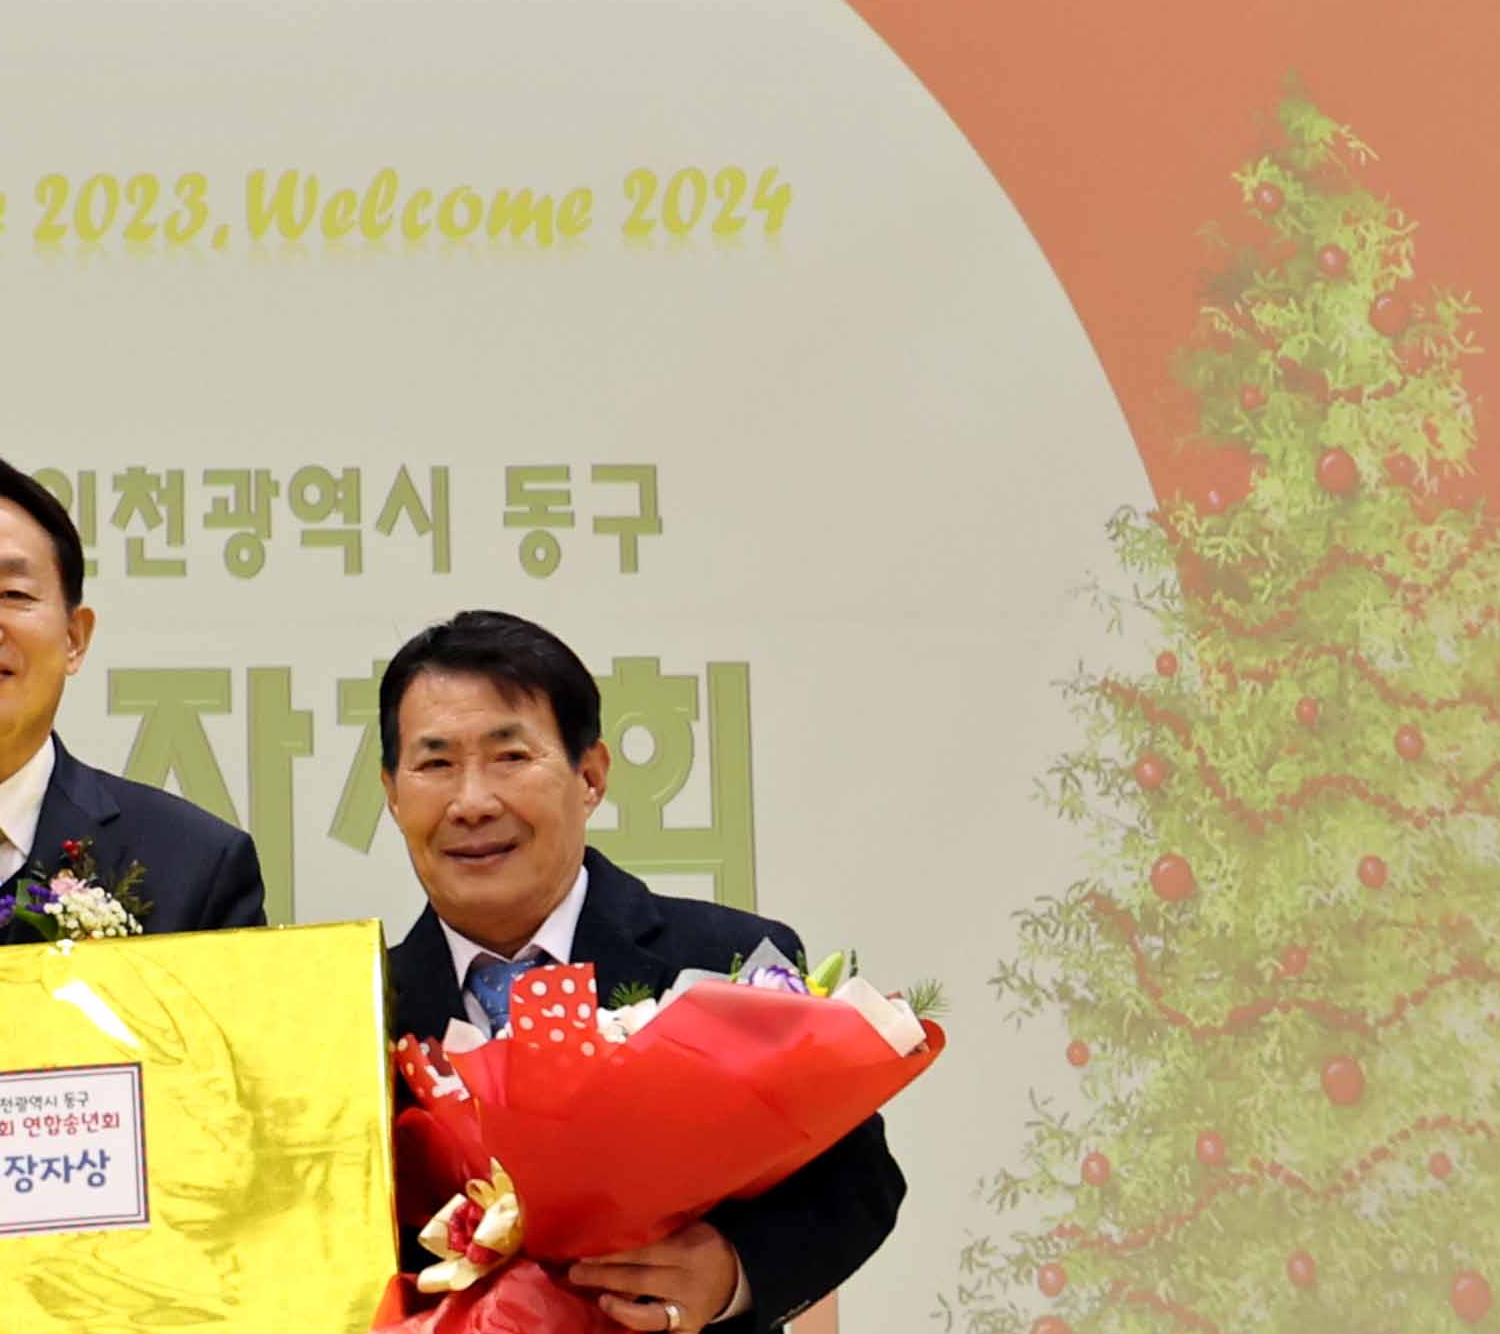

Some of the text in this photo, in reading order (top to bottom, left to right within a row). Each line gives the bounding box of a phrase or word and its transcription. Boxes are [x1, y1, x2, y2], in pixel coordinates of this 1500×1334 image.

[621, 167, 792, 238] 2024
[503, 464, 664, 579] 동구
[63, 1091, 90, 1108] 동구
[22, 1111, 121, 1139] 연합송년회
